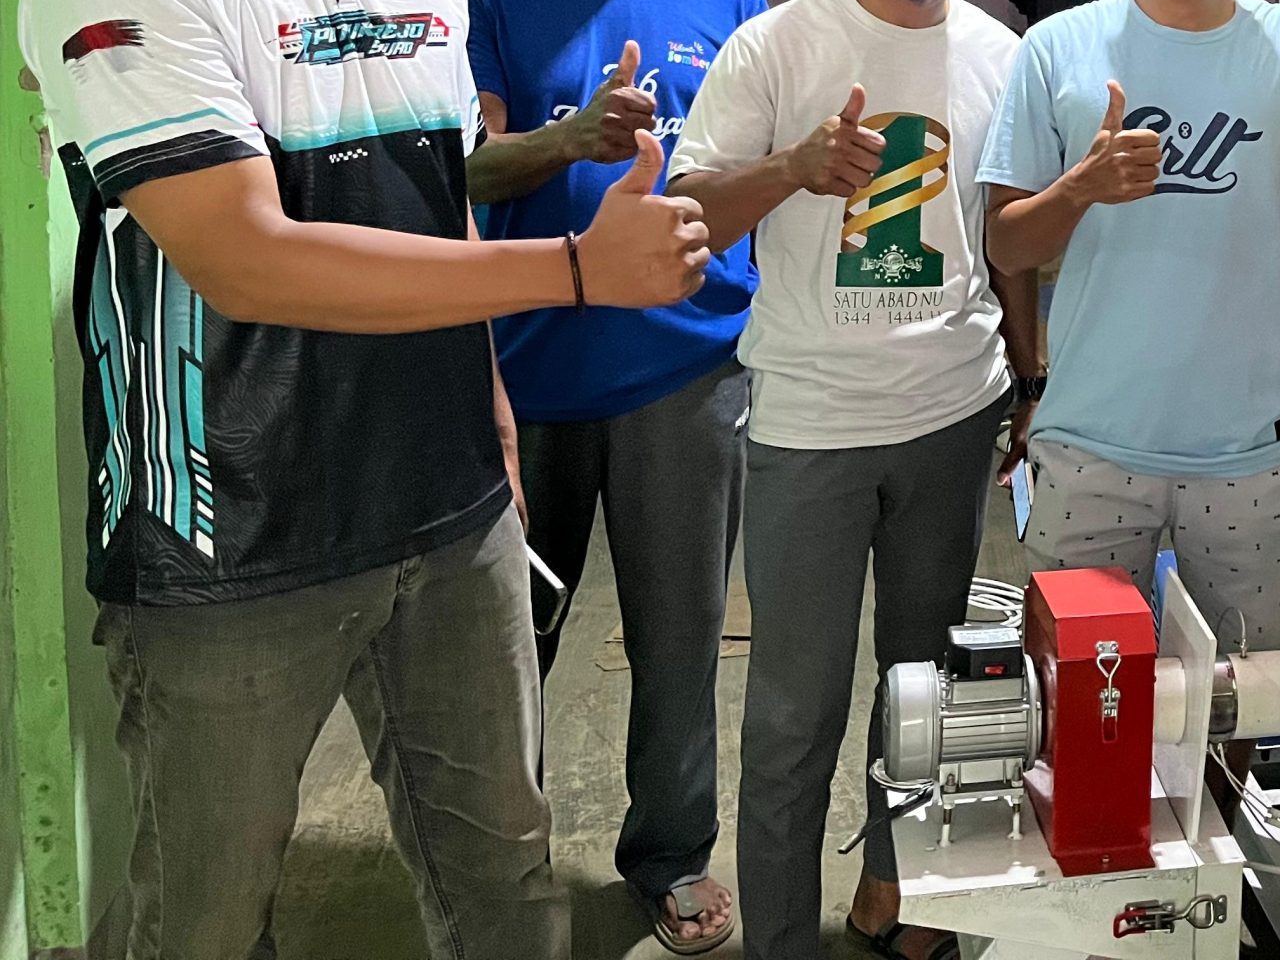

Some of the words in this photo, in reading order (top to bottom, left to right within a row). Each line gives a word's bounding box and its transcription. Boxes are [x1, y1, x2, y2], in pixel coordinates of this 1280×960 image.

[833, 291, 872, 309] SATU
[876, 291, 918, 308] ABAD
[920, 290, 944, 307] NU
[835, 310, 870, 326] 1344
[887, 310, 923, 325] 1444
